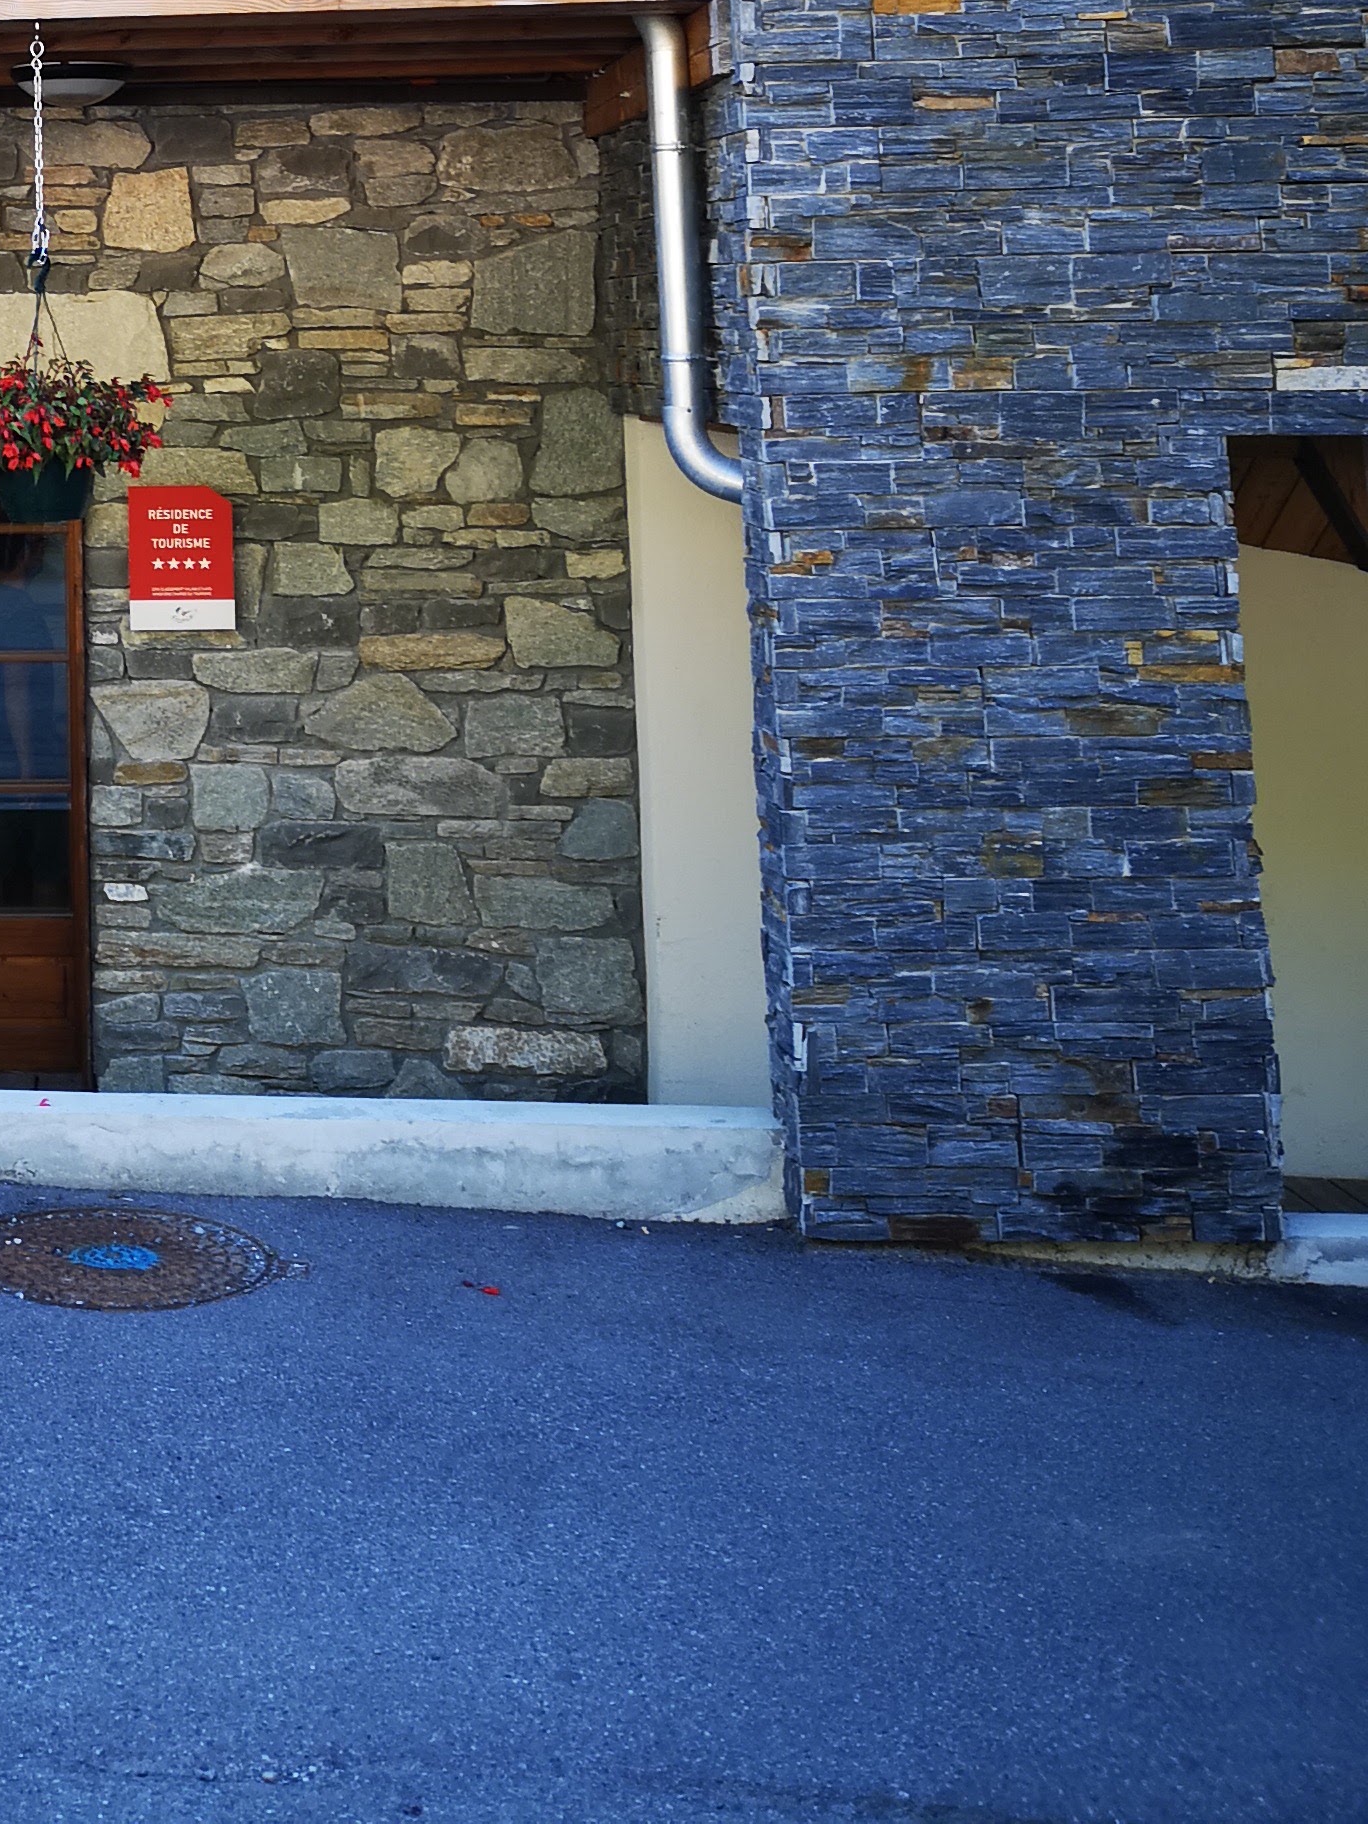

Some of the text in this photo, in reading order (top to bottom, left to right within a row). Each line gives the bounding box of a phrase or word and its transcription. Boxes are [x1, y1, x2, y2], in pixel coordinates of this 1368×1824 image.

[147, 507, 214, 521] RÉSIDENCE
[172, 523, 189, 535] DE
[150, 537, 212, 550] TOURISME
